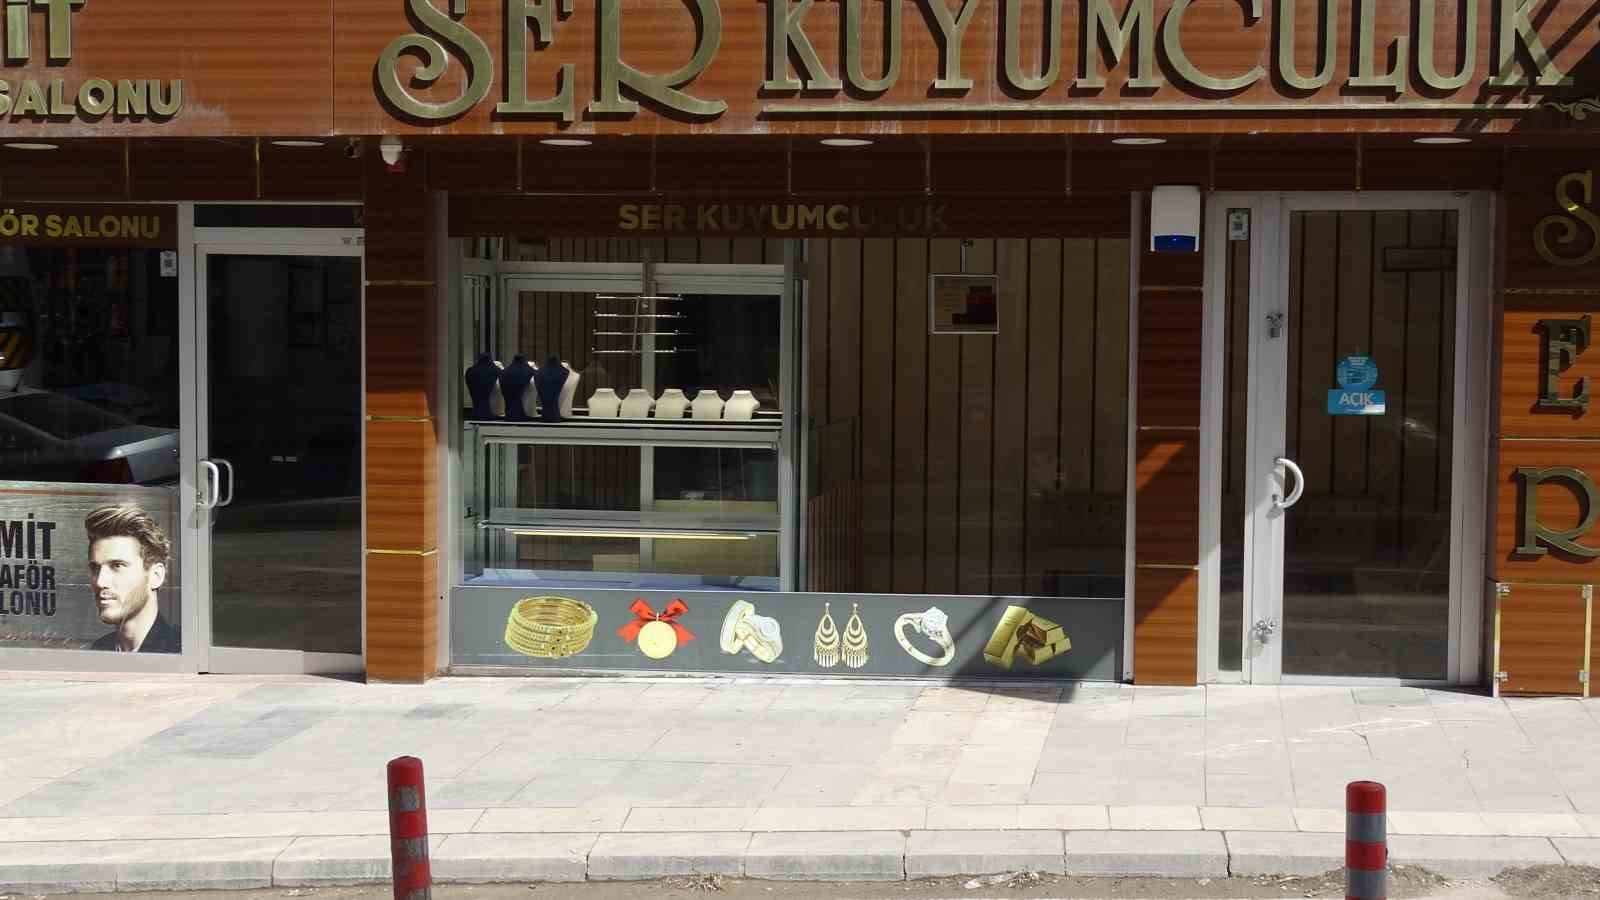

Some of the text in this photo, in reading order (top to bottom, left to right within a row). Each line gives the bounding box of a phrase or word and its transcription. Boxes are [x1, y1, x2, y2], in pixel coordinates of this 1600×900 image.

[377, 0, 1573, 121] SER KUYUMCULUK
[46, 214, 160, 239] SALONU
[618, 204, 948, 232] SER KUYUMCUUK
[1339, 392, 1376, 408] AÇIK
[0, 512, 56, 560] MİT
[0, 560, 56, 590] AFÖR
